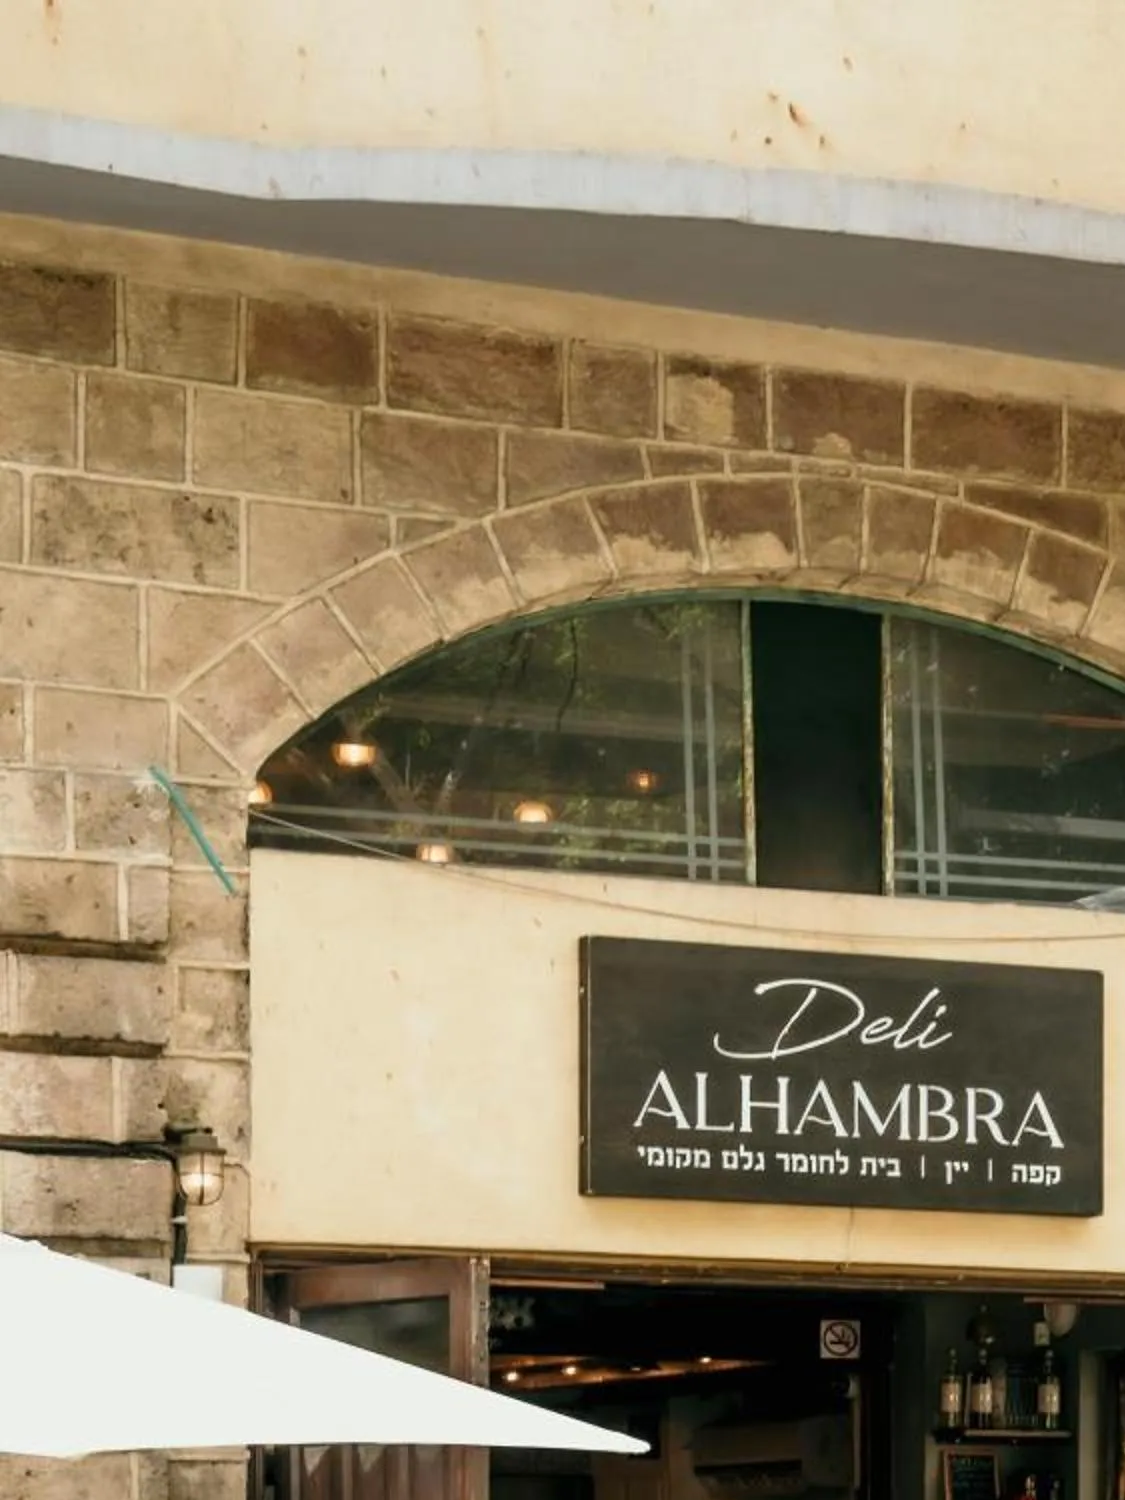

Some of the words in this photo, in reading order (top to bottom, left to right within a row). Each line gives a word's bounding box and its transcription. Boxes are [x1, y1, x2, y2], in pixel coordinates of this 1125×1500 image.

[713, 977, 954, 1061] Deli
[633, 1069, 1065, 1149] ALHAMBRA
[637, 1145, 711, 1170] מקומי
[721, 1143, 766, 1172] גלם
[775, 1148, 850, 1175] לחומר
[860, 1157, 902, 1178] בית
[944, 1161, 969, 1185] יין
[1011, 1163, 1062, 1187] קפה
